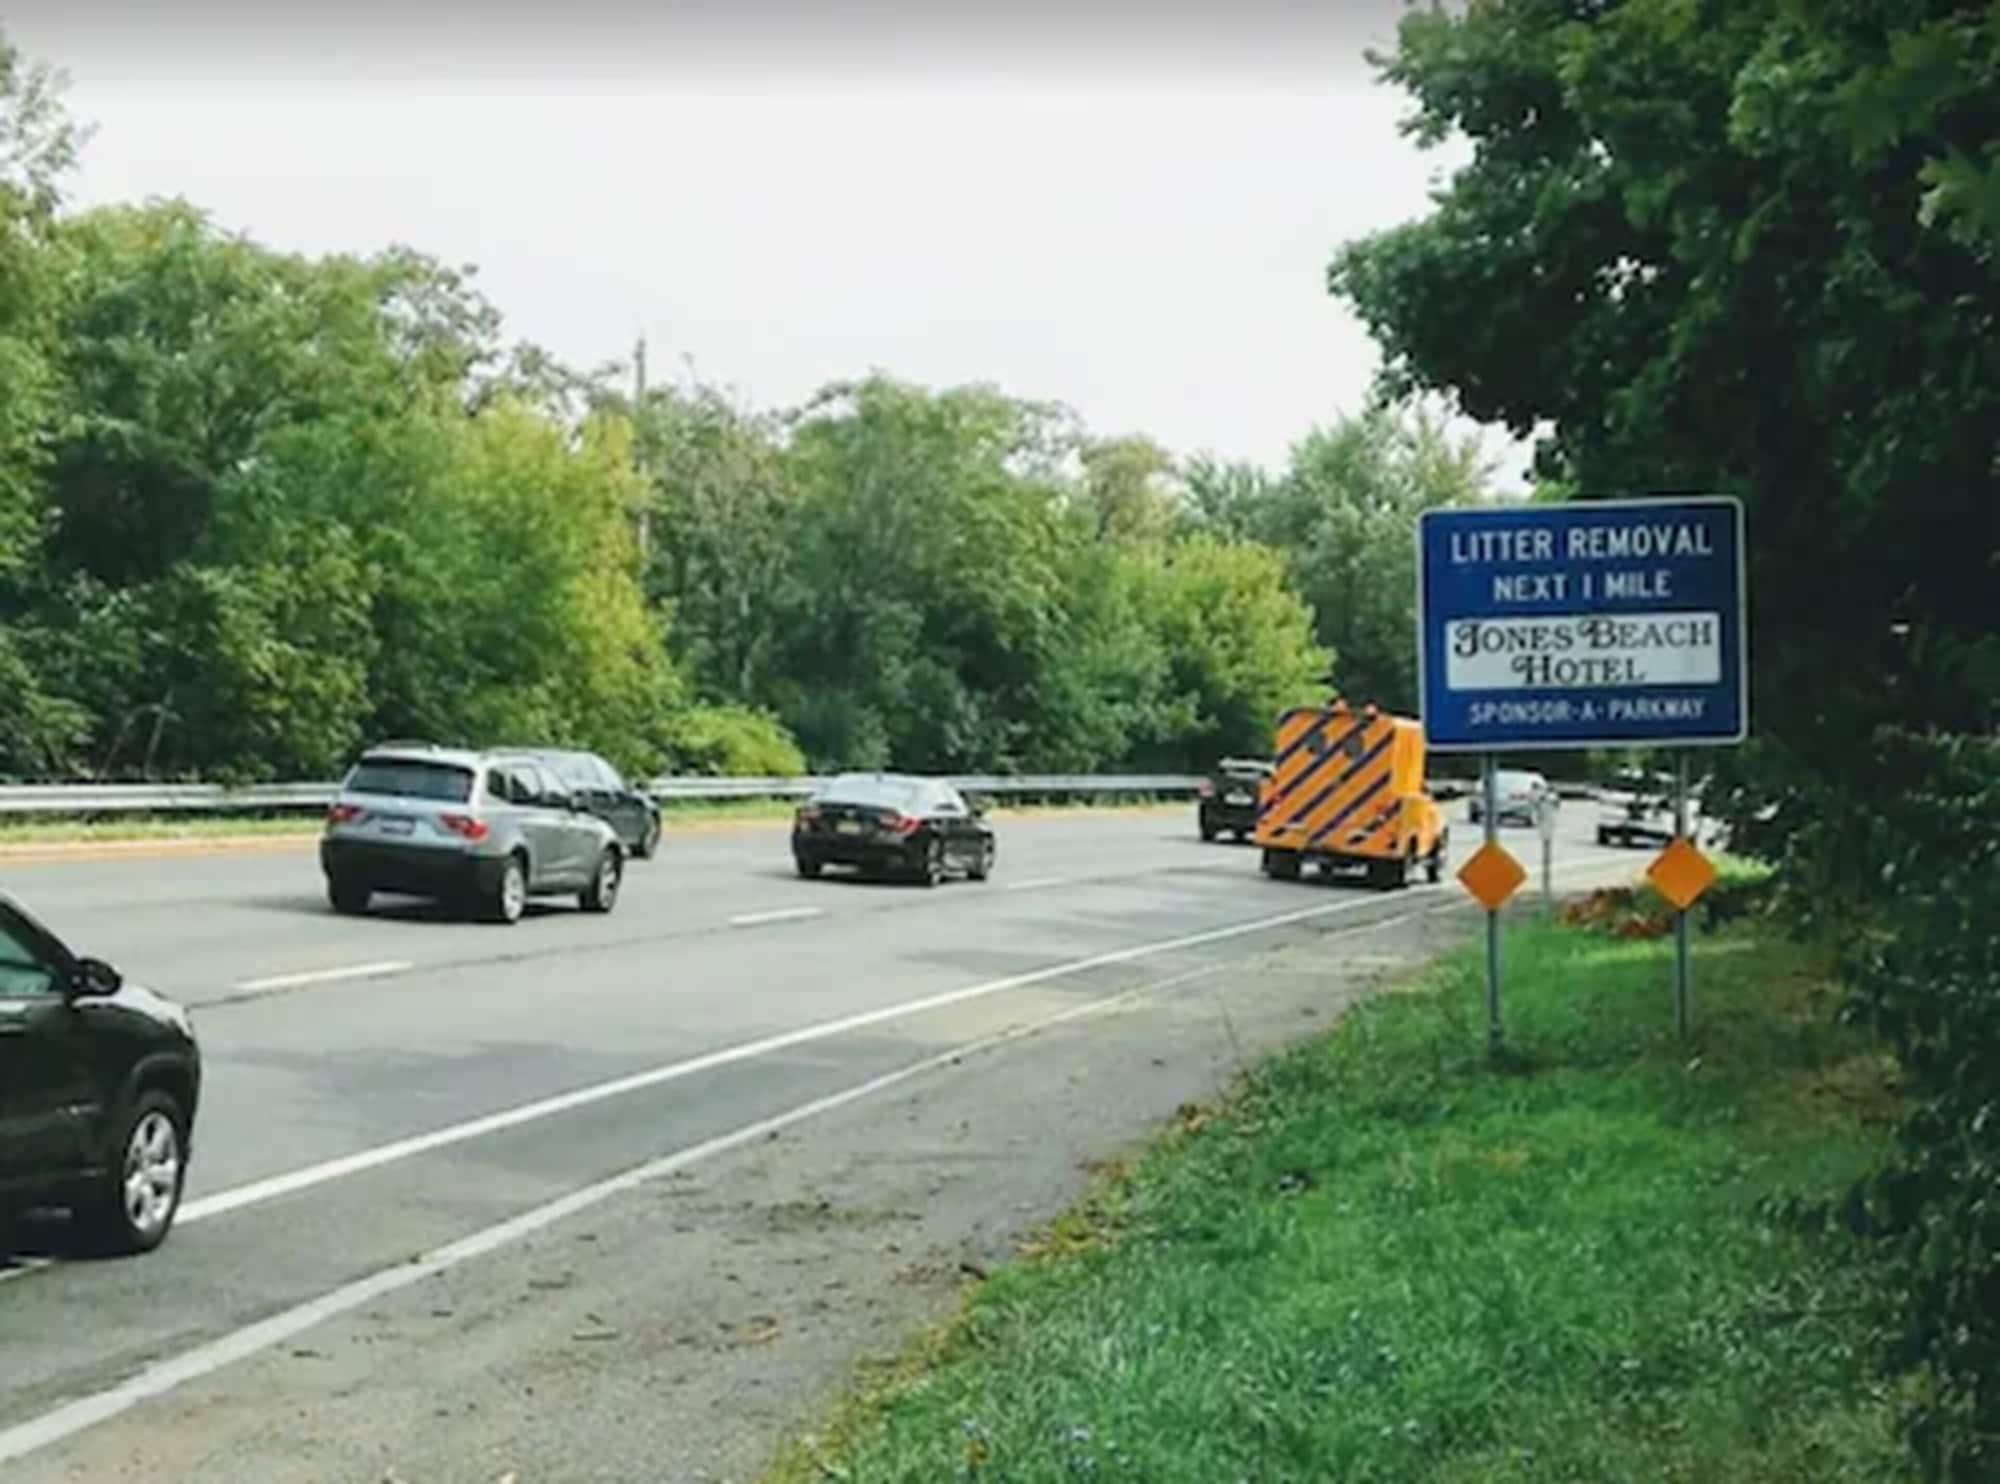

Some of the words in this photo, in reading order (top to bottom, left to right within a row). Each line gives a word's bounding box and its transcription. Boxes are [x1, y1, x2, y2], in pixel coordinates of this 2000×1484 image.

[1451, 529, 1552, 563] LITTER
[1568, 524, 1712, 559] REMOVAL
[1493, 574, 1568, 601] NEXT
[1605, 570, 1672, 598] MILE
[1454, 620, 1573, 657] JONES
[1577, 618, 1712, 650] BEACH
[1511, 654, 1647, 685] HOTEL
